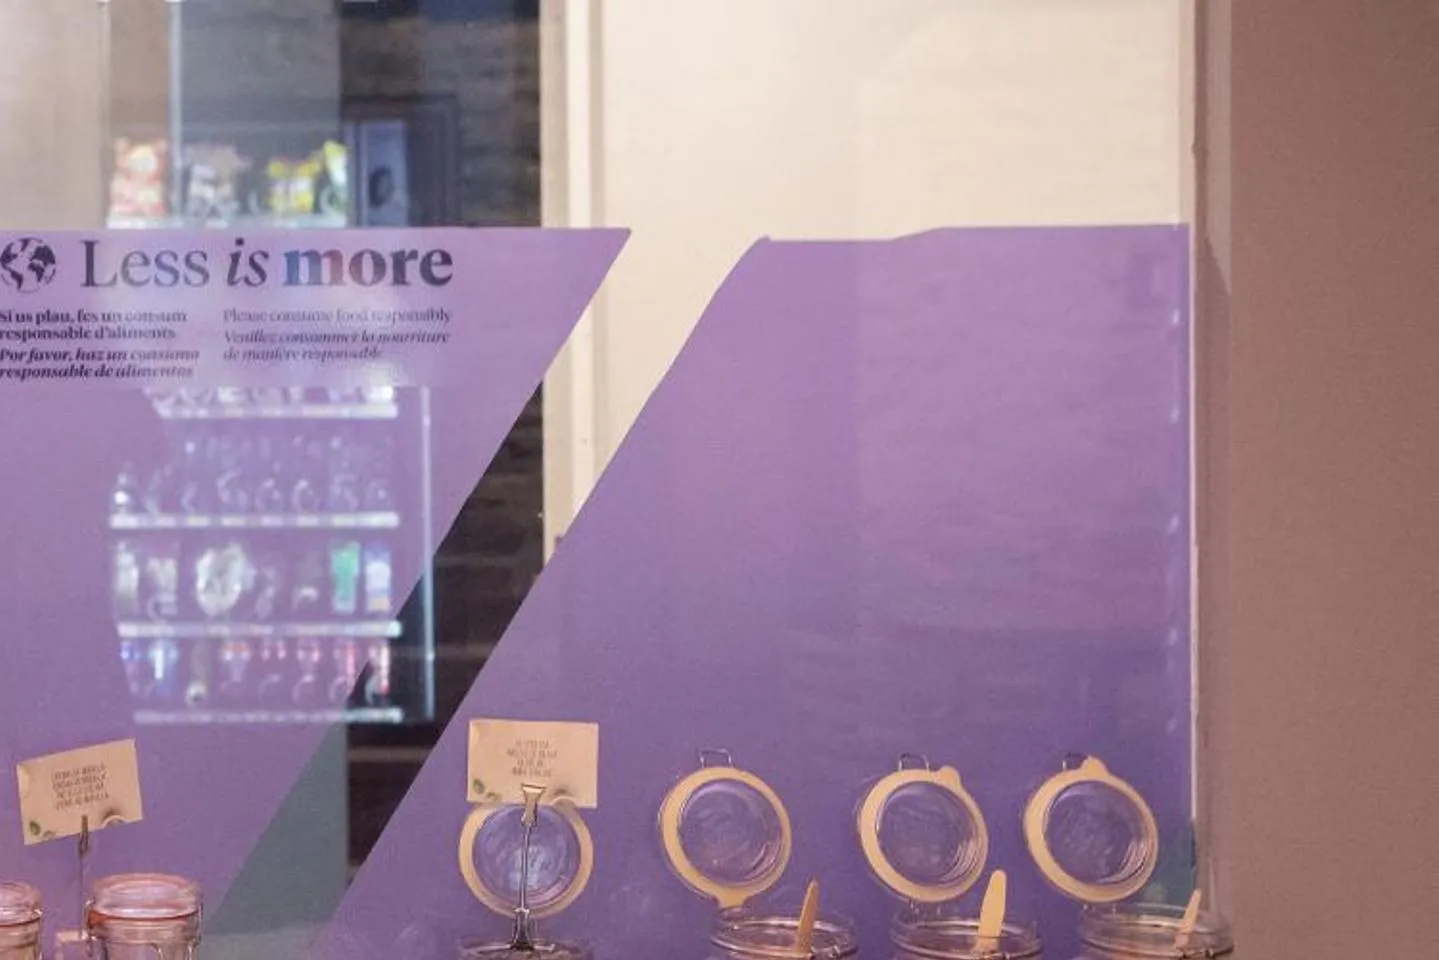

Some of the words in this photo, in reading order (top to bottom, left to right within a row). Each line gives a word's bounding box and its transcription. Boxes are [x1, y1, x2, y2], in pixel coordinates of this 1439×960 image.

[79, 239, 211, 287] Less
[227, 237, 270, 287] is
[282, 247, 454, 287] more
[15, 312, 33, 323] us
[35, 309, 75, 325] plau,
[77, 309, 99, 323] fes
[101, 312, 123, 323] un
[223, 308, 267, 322] Please
[269, 311, 331, 322] consume
[335, 308, 369, 322] food
[371, 308, 452, 325] responsibly
[361, 330, 375, 343] la
[377, 331, 451, 344] nourriture
[26, 348, 73, 364] favor,
[74, 348, 104, 362] haz
[106, 350, 129, 362] un
[223, 346, 240, 359] de
[94, 364, 114, 378] de
[114, 364, 195, 378] alimentos
